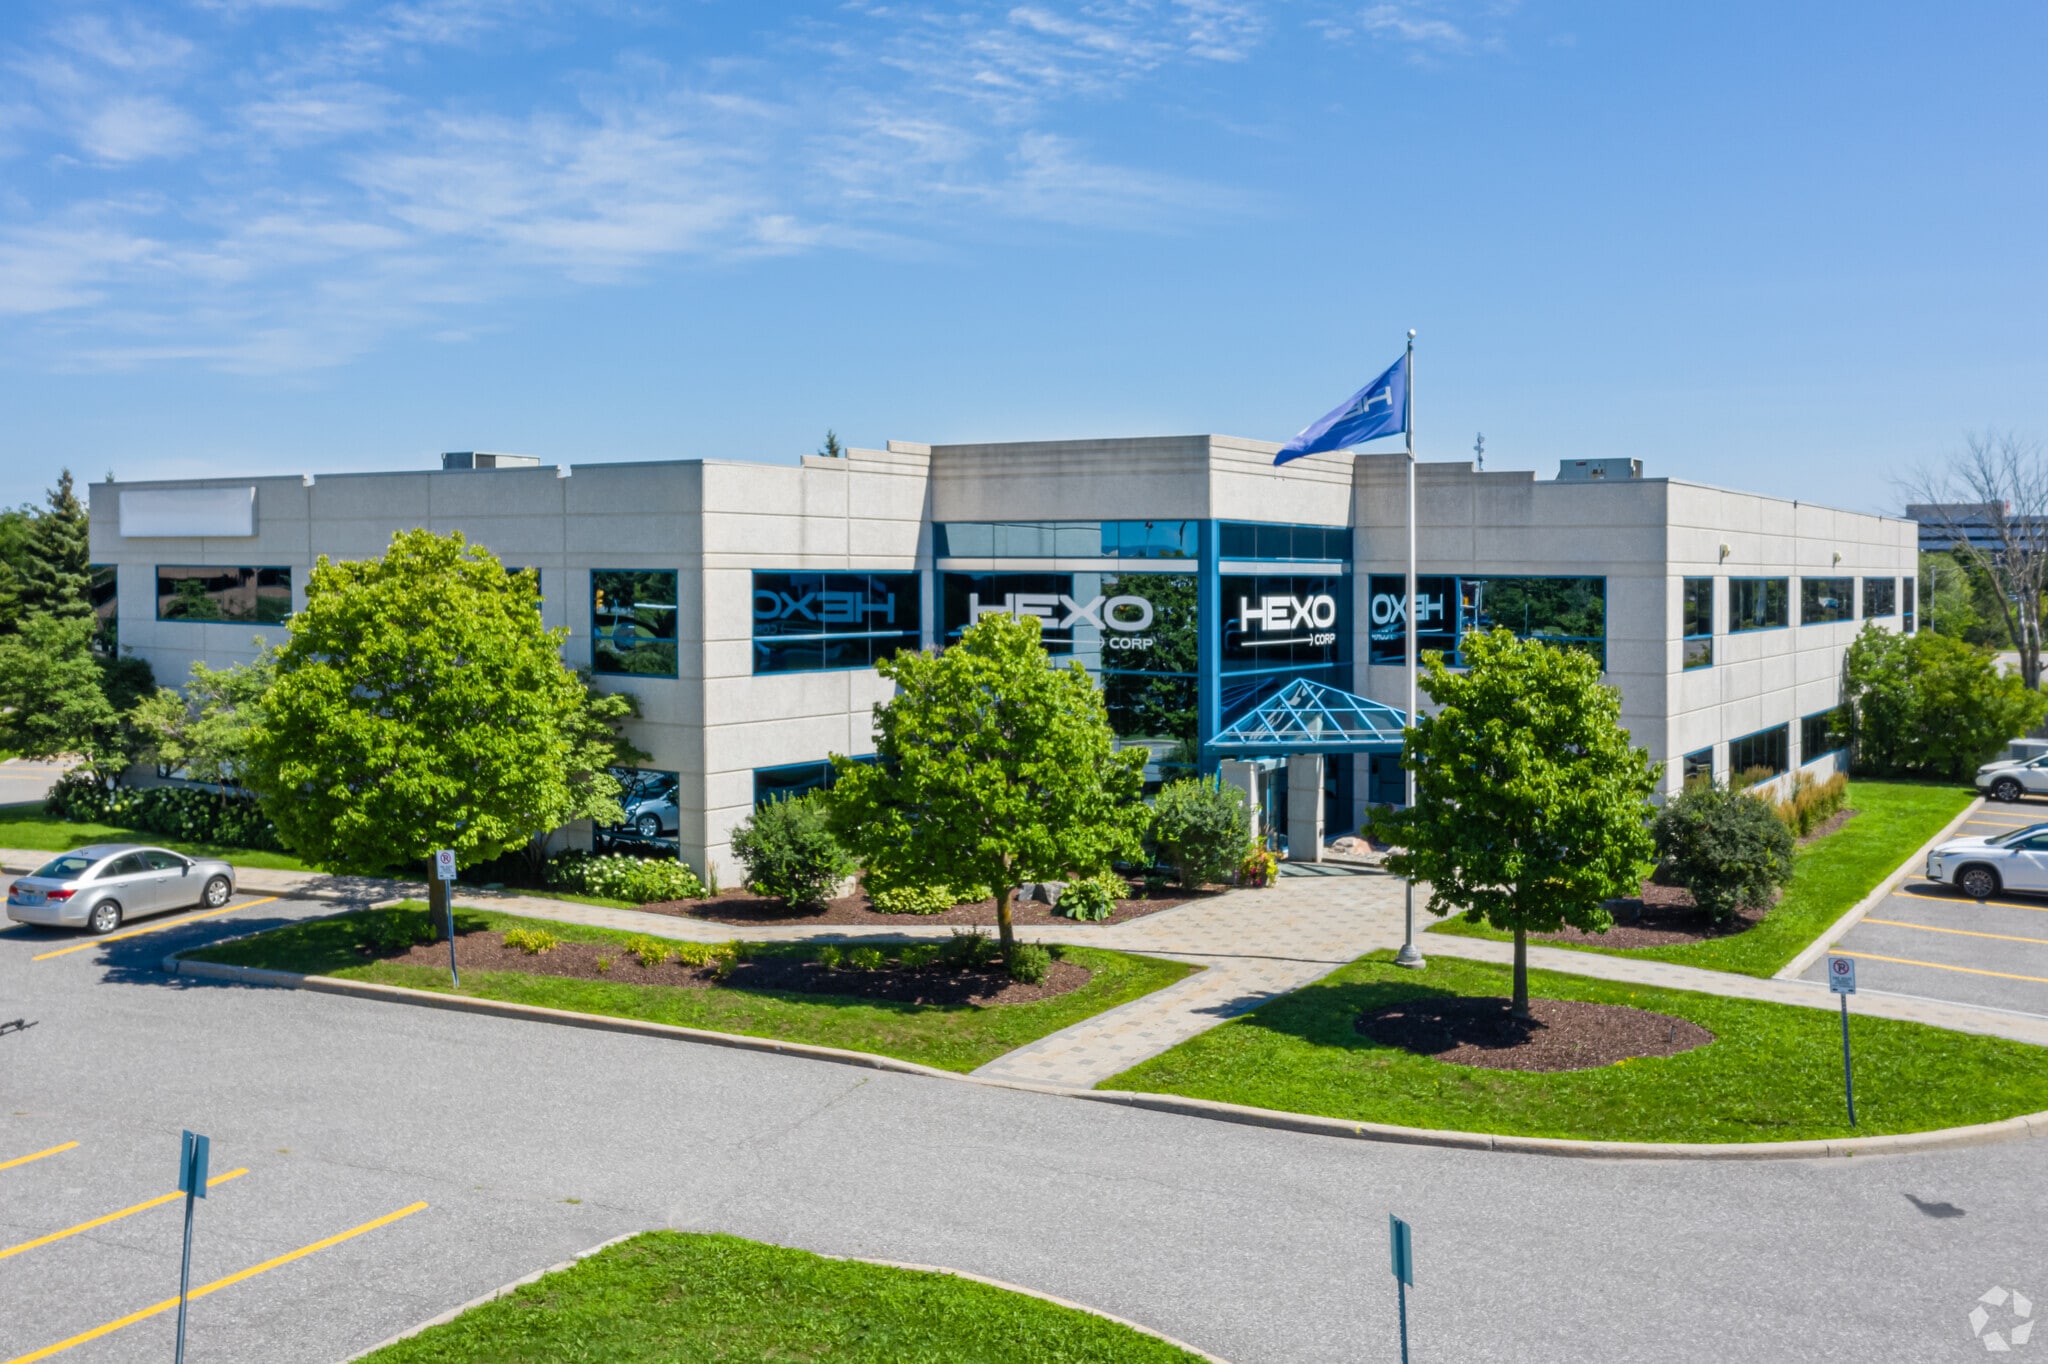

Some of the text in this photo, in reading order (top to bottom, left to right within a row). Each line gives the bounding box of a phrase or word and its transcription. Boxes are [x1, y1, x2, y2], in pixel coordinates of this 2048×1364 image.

[969, 593, 1154, 631] HEXO
[1241, 594, 1336, 632] HEXO
[1109, 637, 1154, 650] CORP
[1314, 633, 1336, 646] CORP
